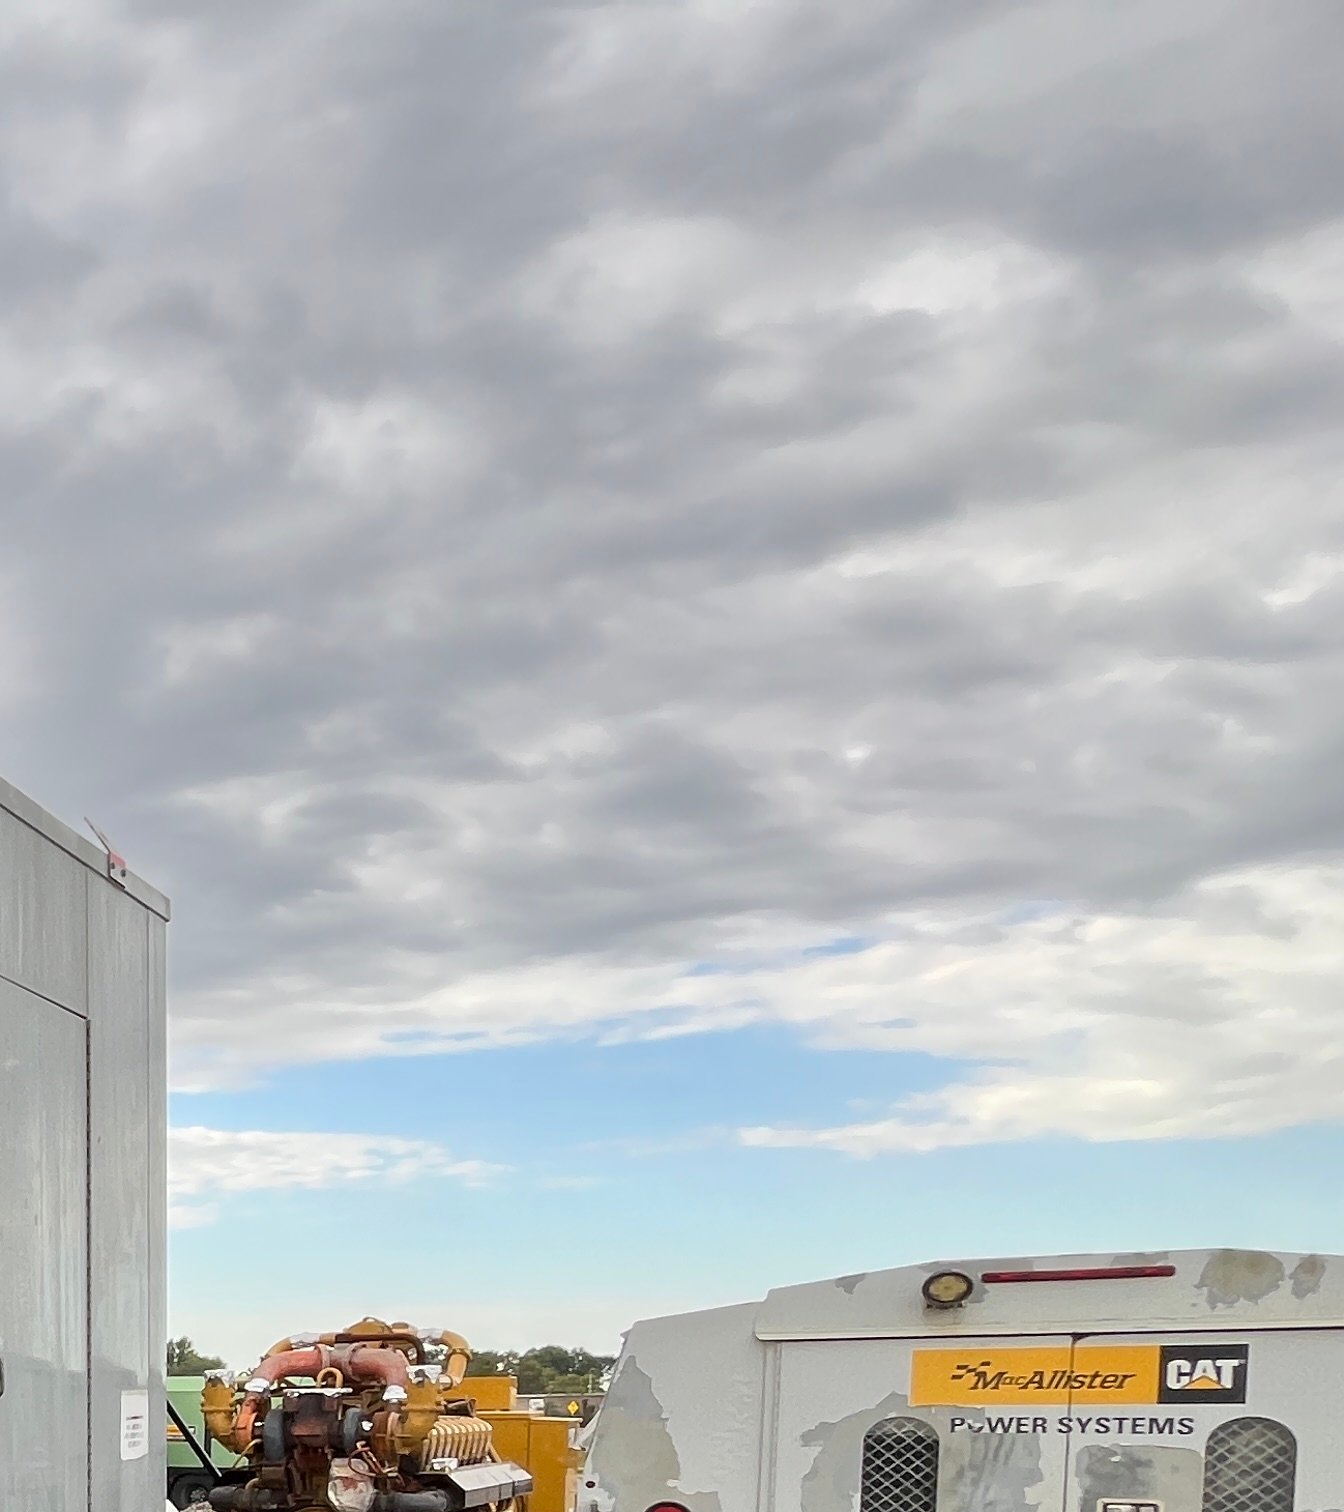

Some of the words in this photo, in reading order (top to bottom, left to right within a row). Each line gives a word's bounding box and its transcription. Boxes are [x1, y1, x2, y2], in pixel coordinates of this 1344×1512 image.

[968, 1370, 1137, 1390] MacAllister
[1166, 1359, 1239, 1389] CAT
[1056, 1416, 1195, 1435] SYSTEMS
